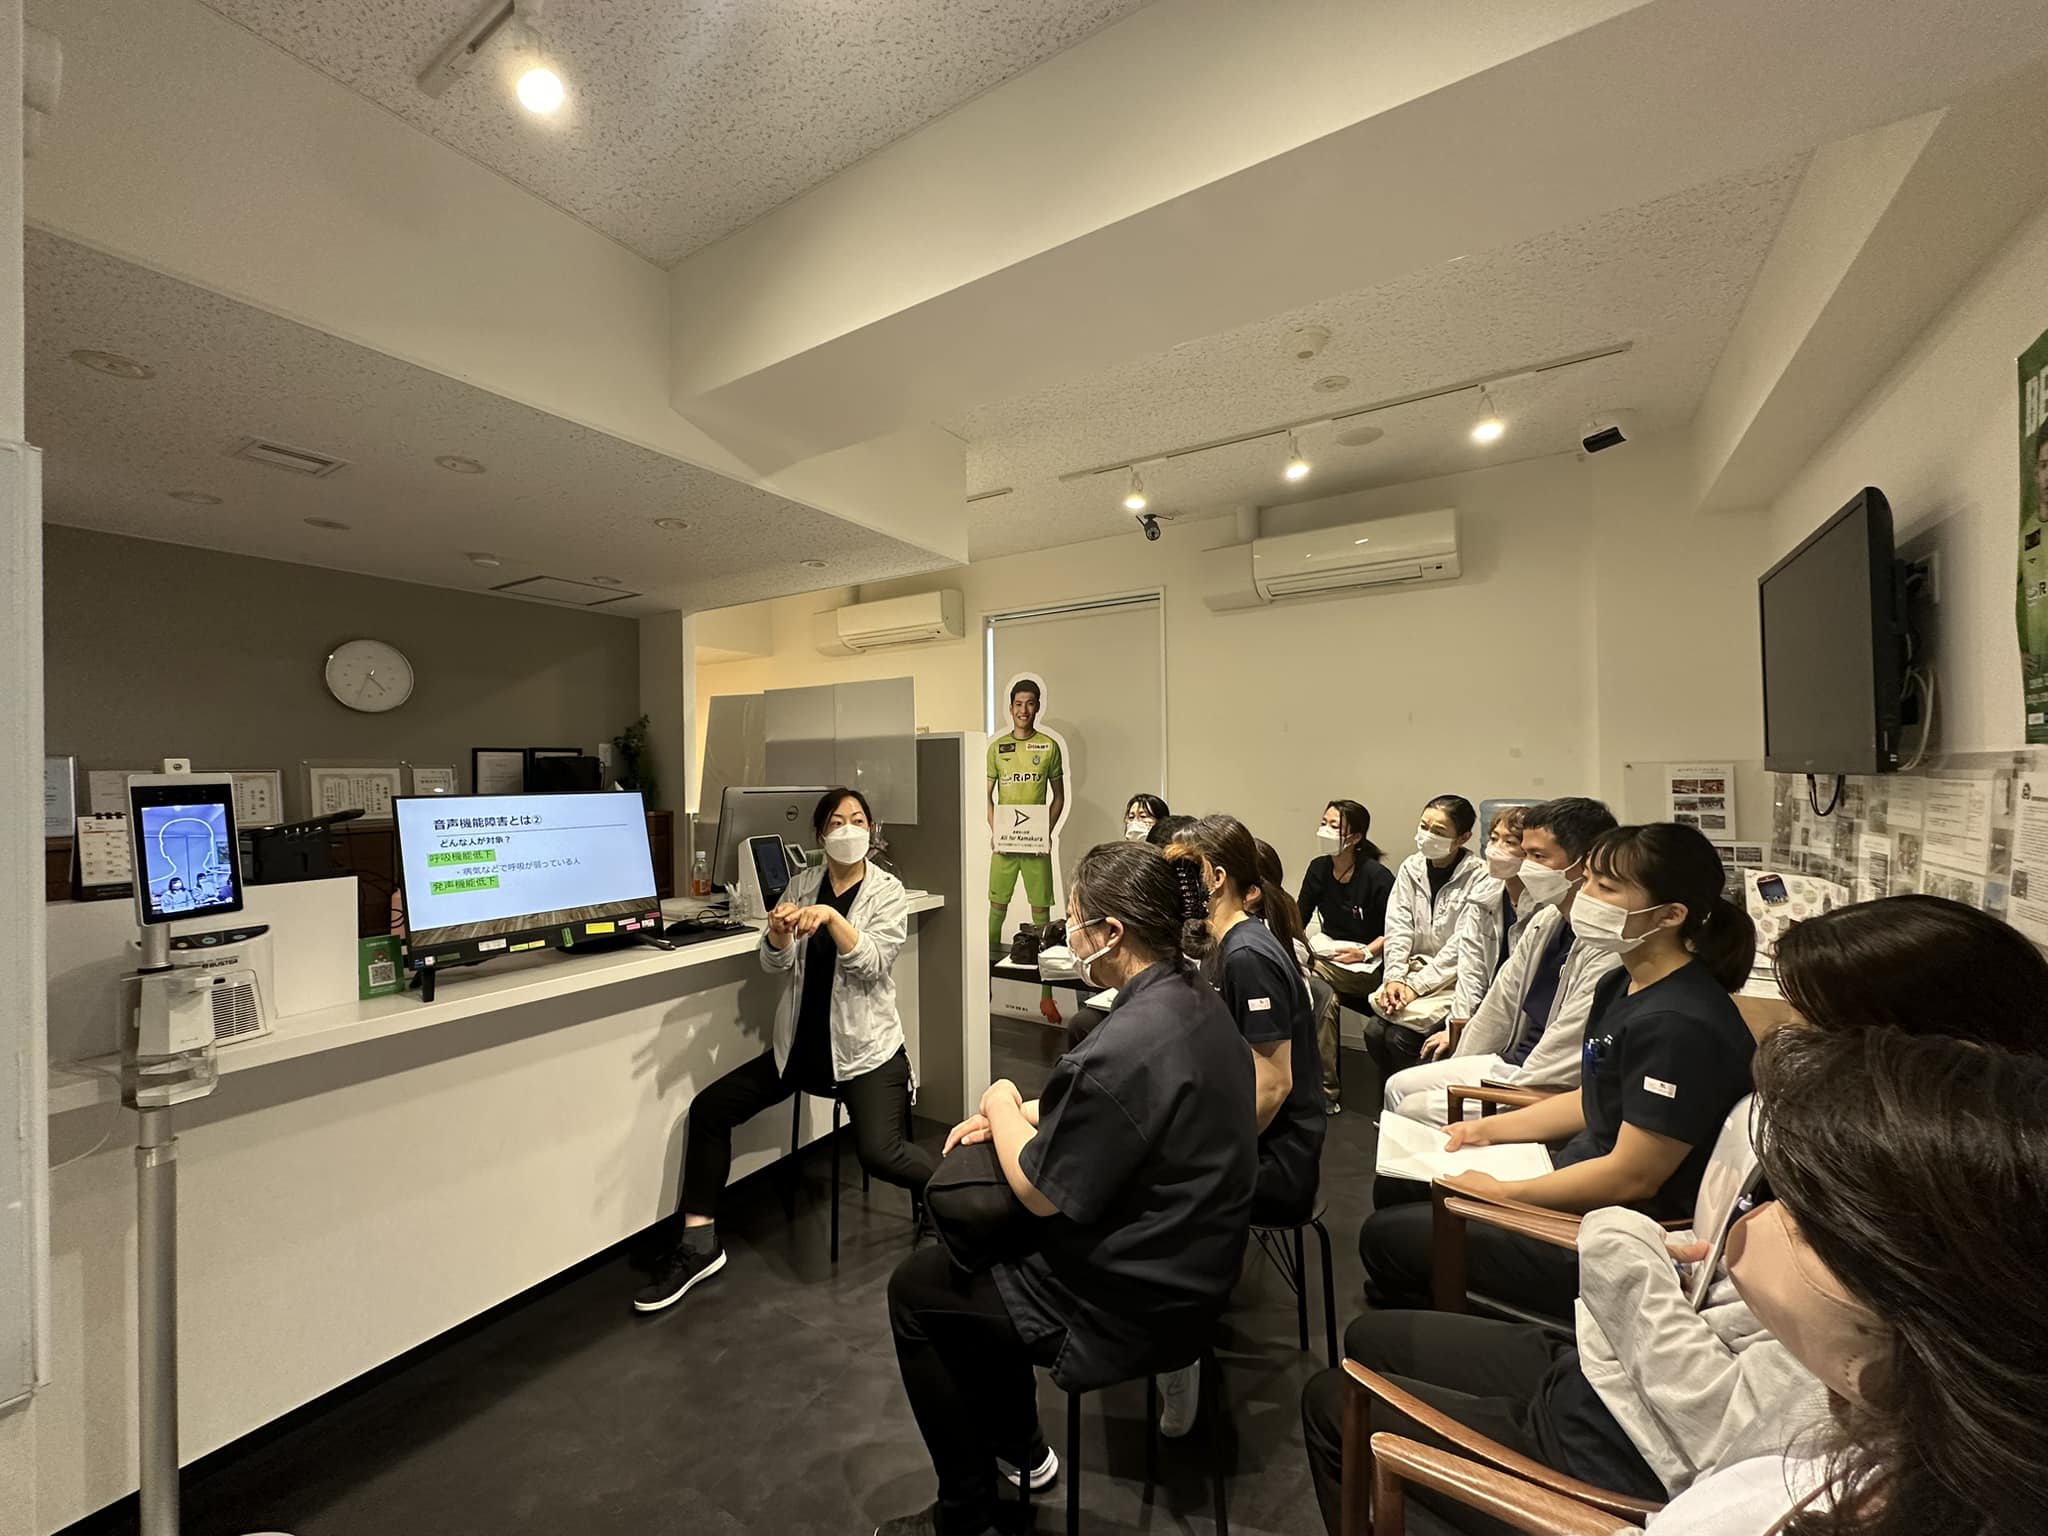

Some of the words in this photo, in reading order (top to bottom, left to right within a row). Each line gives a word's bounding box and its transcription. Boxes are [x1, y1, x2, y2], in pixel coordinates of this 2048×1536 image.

[433, 815, 542, 830] 音声機能障害とは②
[440, 836, 511, 848] どんな人が対象？
[430, 850, 492, 864] 呼吸機能低下
[433, 876, 496, 892] 発声機能低下
